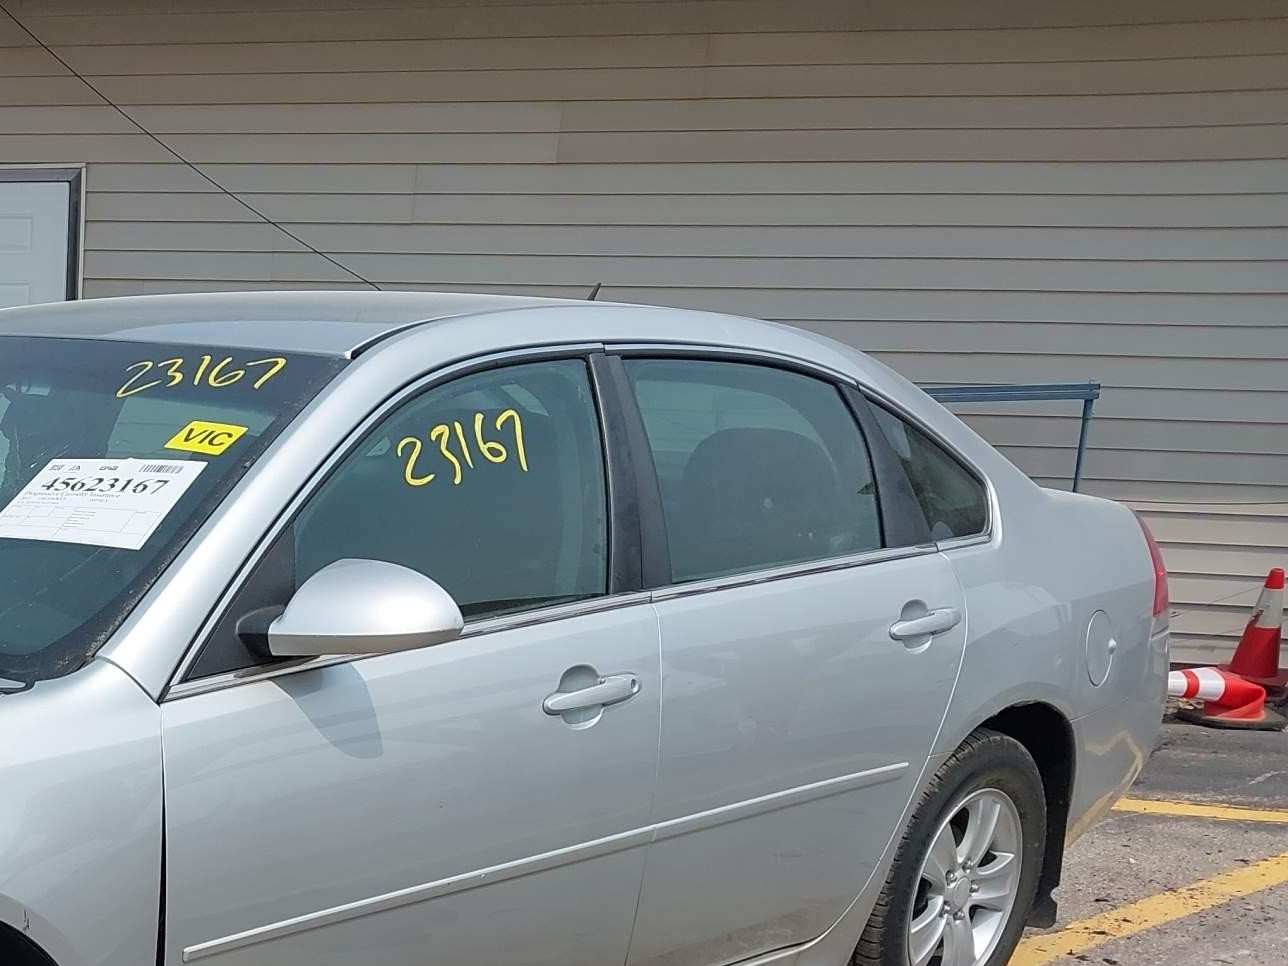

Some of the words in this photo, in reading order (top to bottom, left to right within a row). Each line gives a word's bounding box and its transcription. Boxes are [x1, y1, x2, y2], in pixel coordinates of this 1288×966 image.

[116, 355, 288, 397] 23167
[182, 427, 234, 447] VIC
[396, 409, 528, 485] 23167
[42, 477, 170, 494] 45623167
